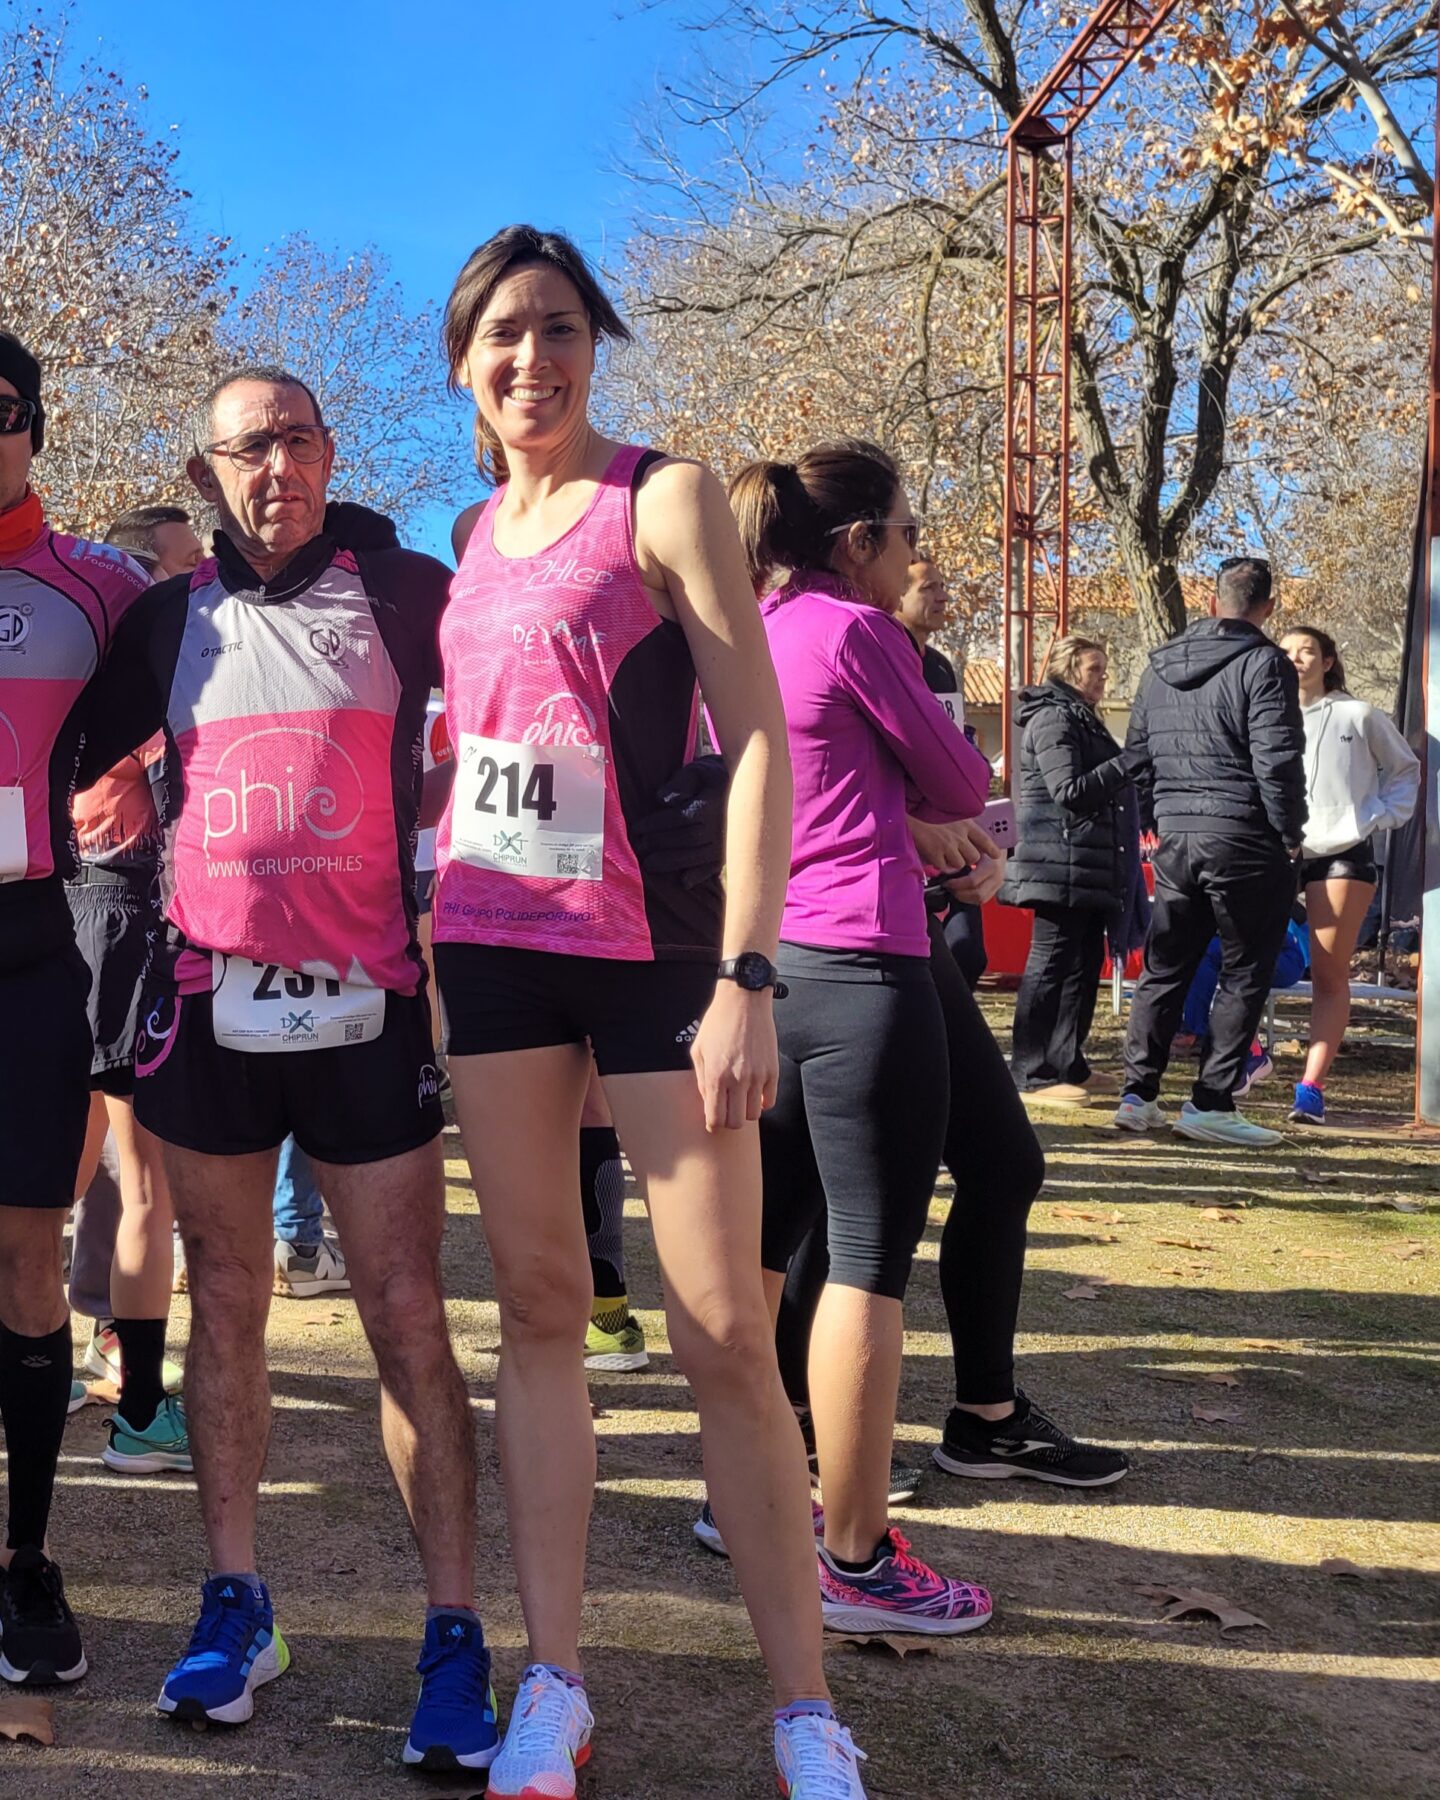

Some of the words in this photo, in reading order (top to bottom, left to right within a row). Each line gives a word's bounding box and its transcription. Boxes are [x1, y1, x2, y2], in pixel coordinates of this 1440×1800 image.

[83, 555, 114, 571] Food
[211, 641, 243, 658] TACTIC
[474, 756, 557, 821] 214
[206, 855, 363, 878] WWW.GRUPOPHI.ES
[492, 853, 528, 864] CHIPRUN
[282, 1033, 319, 1042] CHIPRUN
